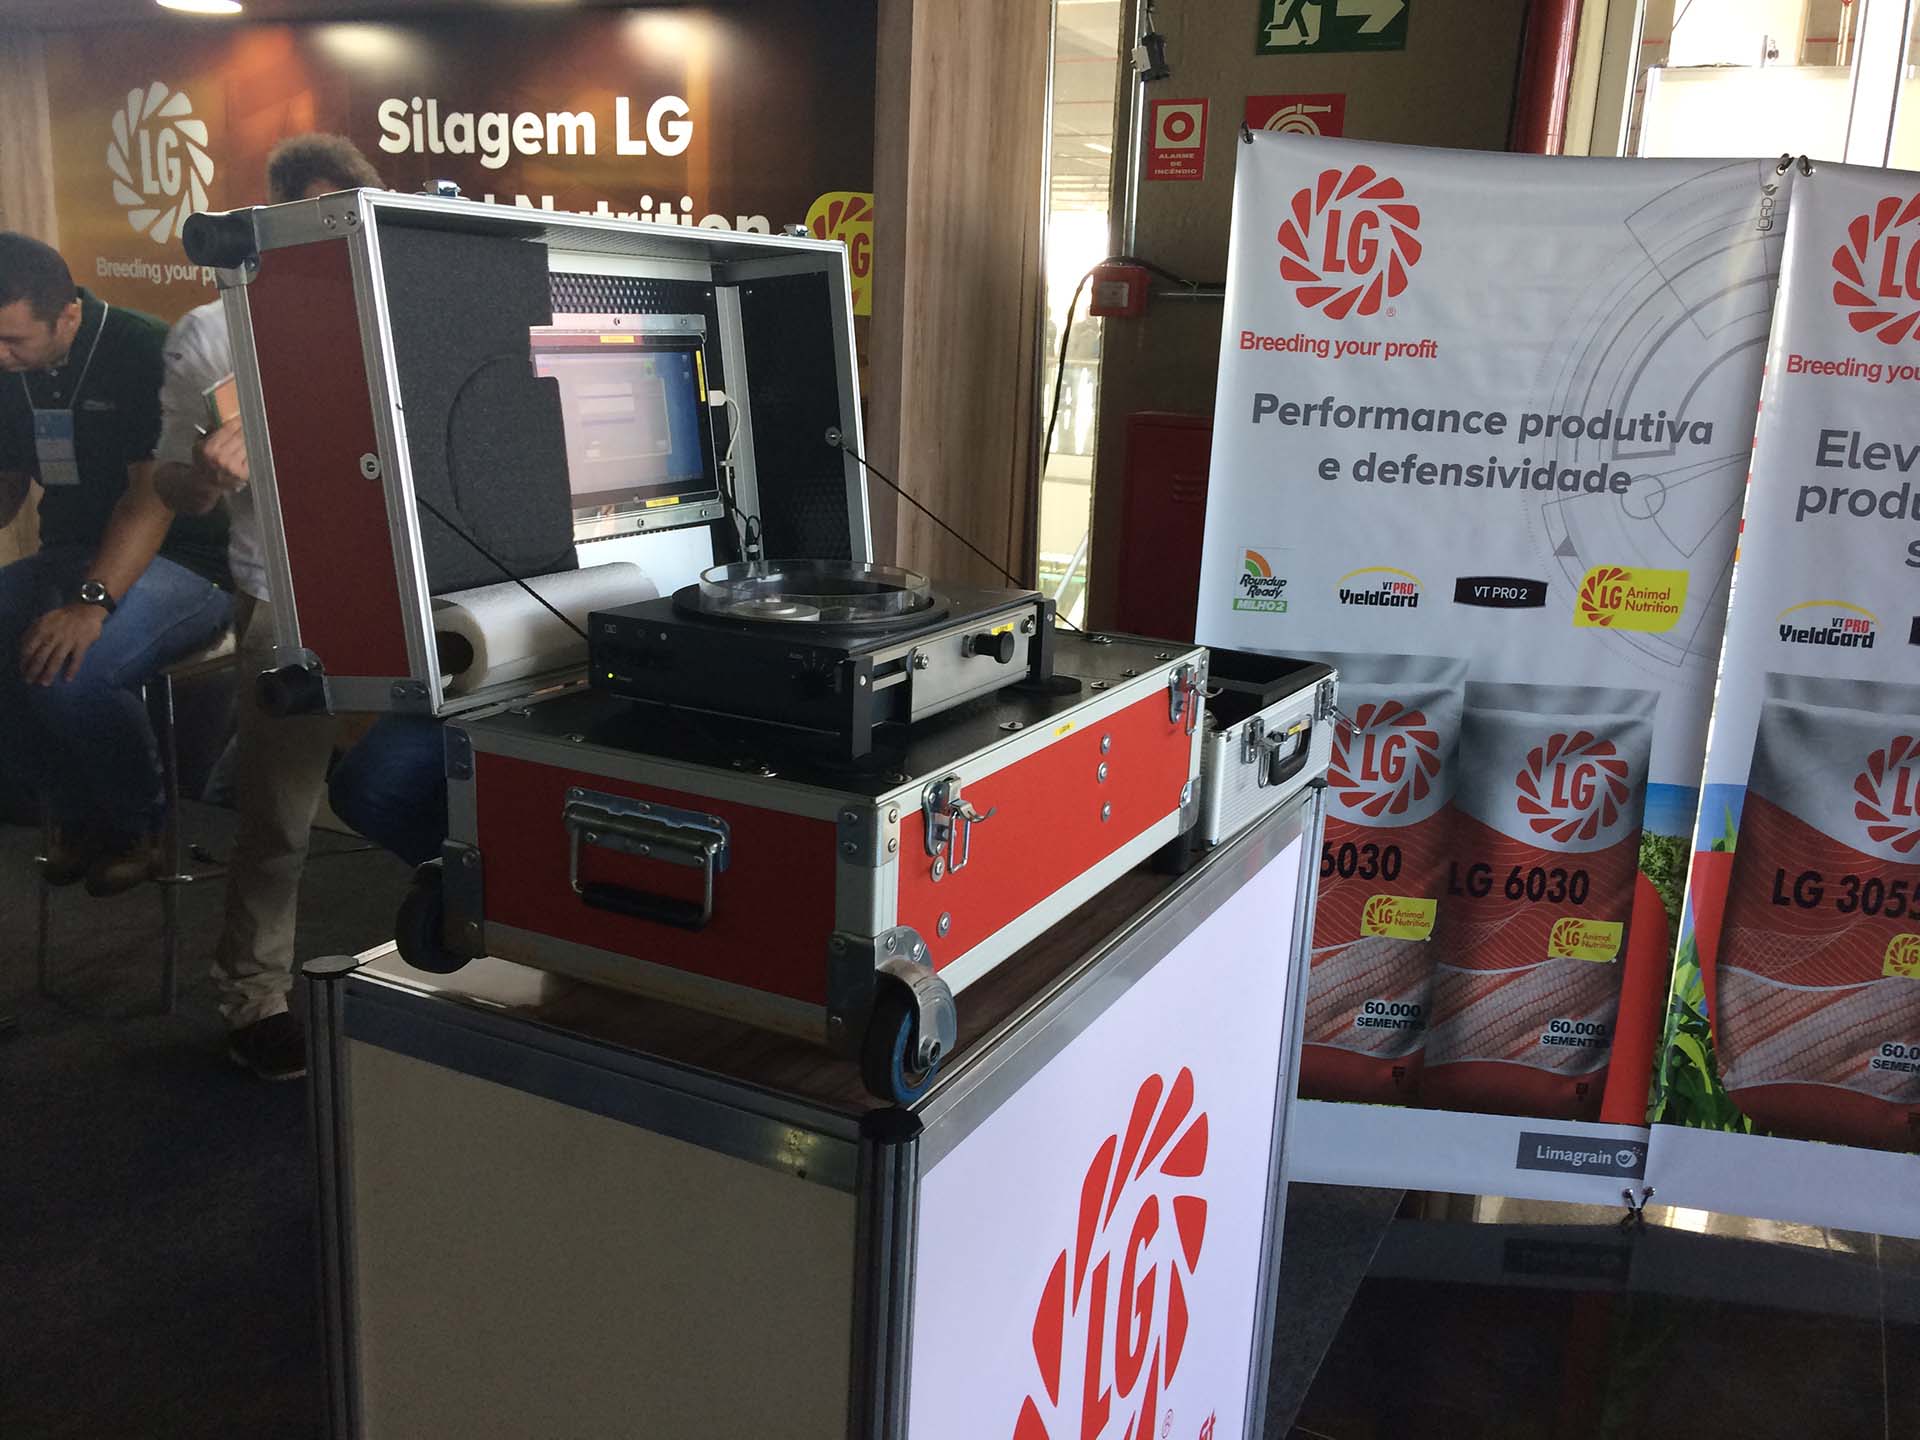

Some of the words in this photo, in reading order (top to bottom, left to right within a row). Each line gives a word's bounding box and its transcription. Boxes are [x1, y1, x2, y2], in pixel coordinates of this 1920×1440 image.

[377, 96, 596, 170] Silagem
[615, 95, 694, 158] LG
[139, 127, 182, 196] LG
[1322, 209, 1380, 276] LG
[96, 256, 162, 285] Breeding
[163, 263, 199, 286] your
[1239, 330, 1330, 359] Breeding
[1333, 338, 1381, 360] your
[1384, 338, 1439, 361] profit
[1786, 354, 1882, 383] Breeding
[1251, 392, 1508, 437] Performance
[1518, 408, 1715, 446] produtiva
[1815, 429, 1920, 472] Elev
[1317, 458, 1341, 482] e
[1351, 452, 1633, 495] defensividade
[1240, 574, 1287, 589] Roundup
[1246, 586, 1283, 599] Ready
[1474, 586, 1491, 599] VT
[1492, 586, 1518, 600] PRO
[1519, 588, 1528, 600] 2
[1626, 587, 1671, 601] Animal
[1339, 589, 1419, 608] YieldGard
[1599, 585, 1622, 610] LG
[1625, 600, 1679, 614] Nutrition
[1779, 624, 1875, 649] YieldGard
[1360, 732, 1407, 783] LG
[1551, 761, 1597, 811] LG
[1446, 861, 1494, 898] LG
[1504, 866, 1591, 905] 6030
[1772, 868, 1825, 909] LG
[1378, 909, 1393, 924] LG
[1394, 918, 1431, 928] Nutrition
[1396, 910, 1425, 919] Animal
[1565, 931, 1580, 946] LG
[1902, 948, 1919, 965] LG
[1365, 1002, 1421, 1017] 60.000
[1550, 1020, 1605, 1036] 60.000
[1536, 1145, 1612, 1167] Limagrain
[1081, 1193, 1161, 1440] LG
